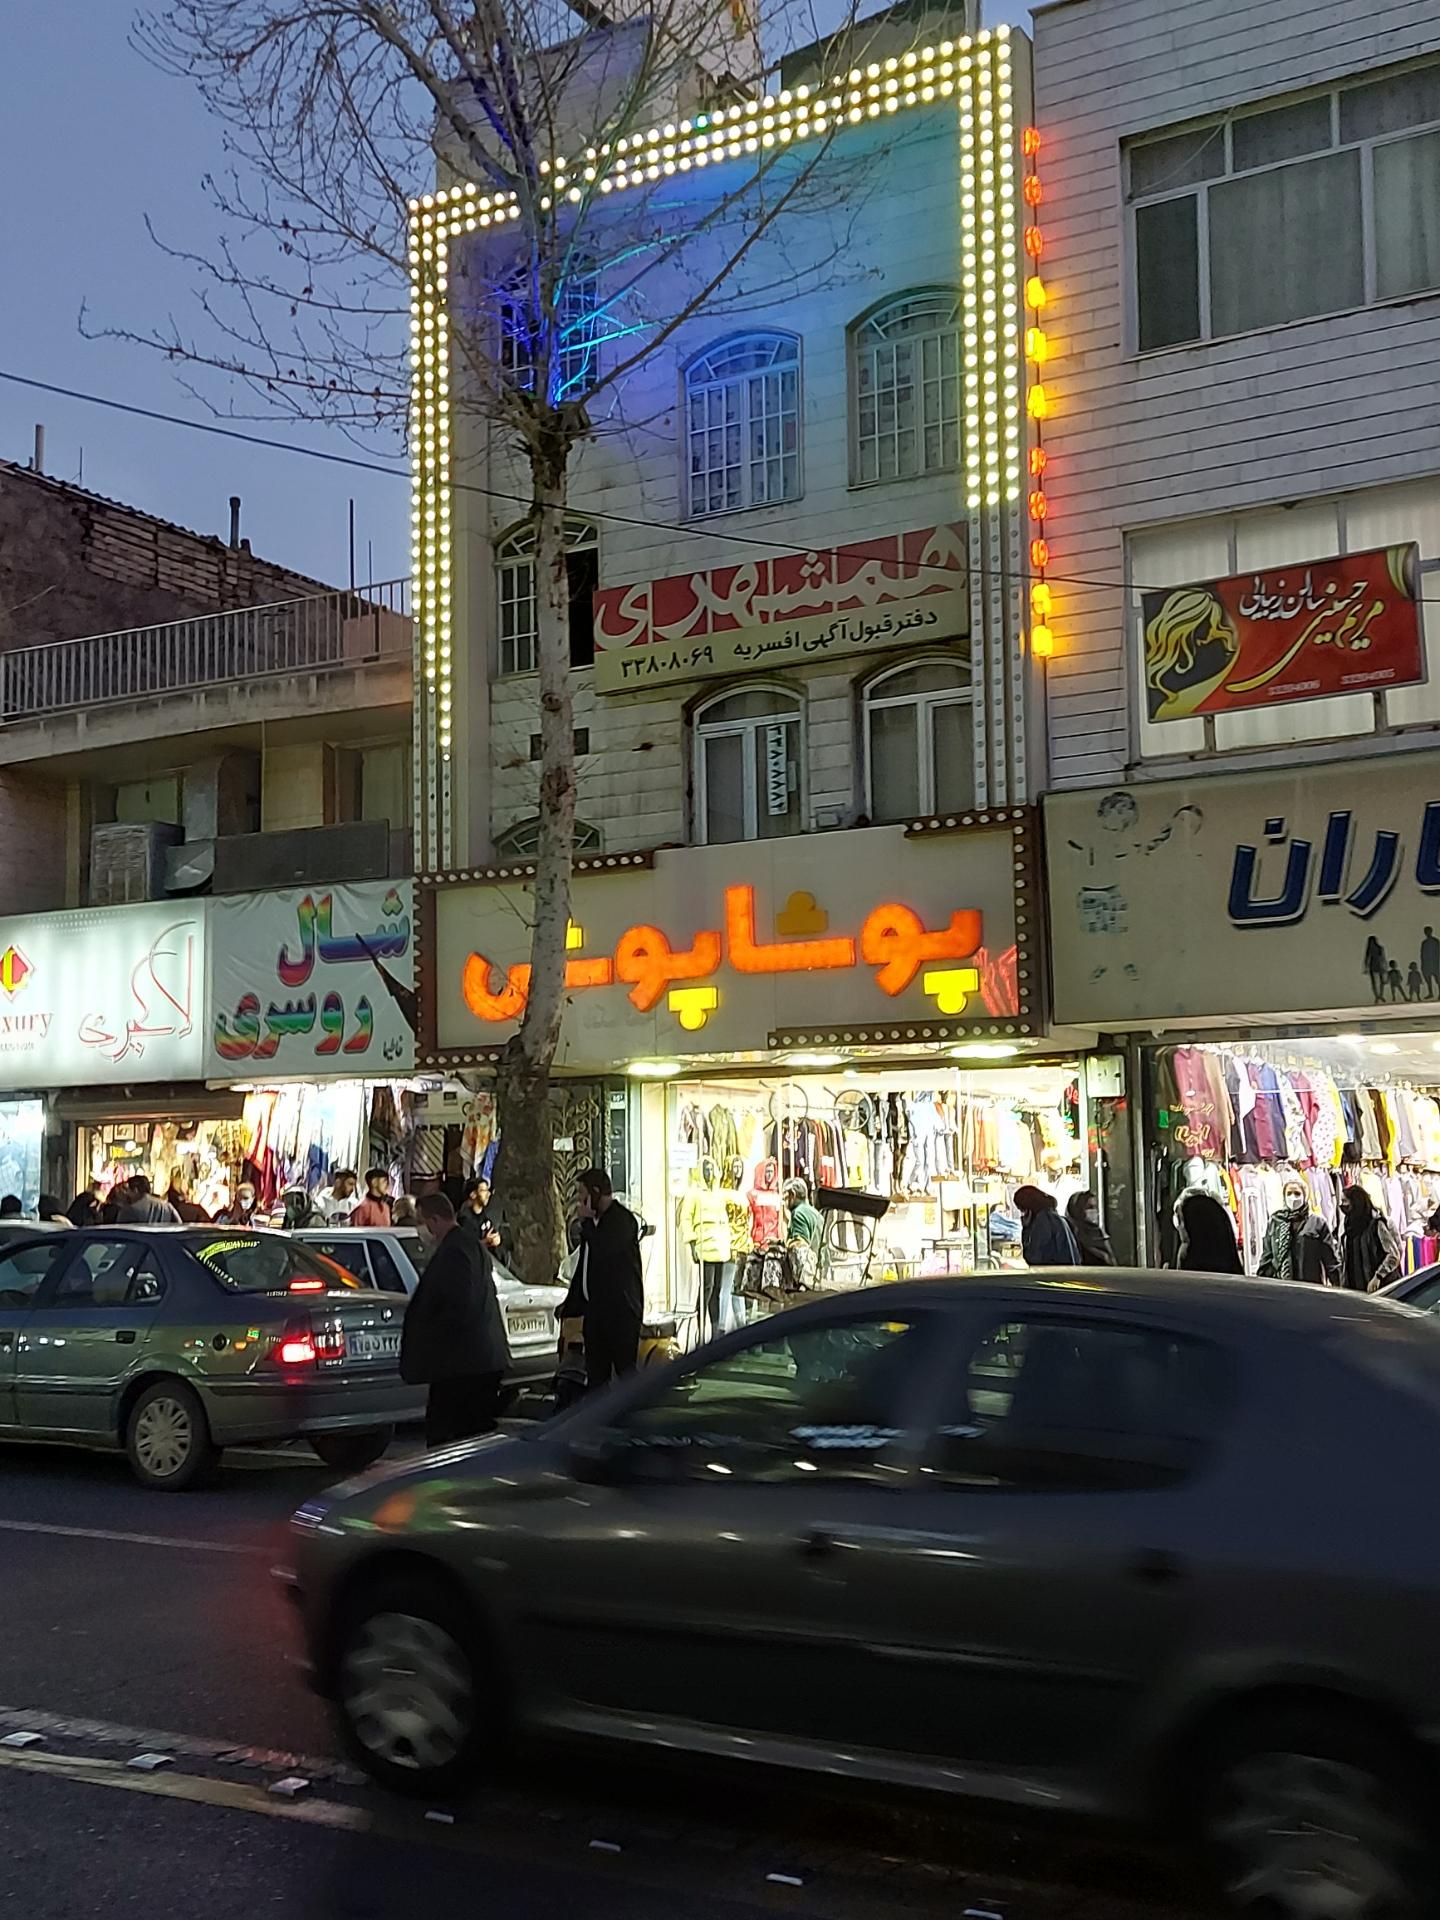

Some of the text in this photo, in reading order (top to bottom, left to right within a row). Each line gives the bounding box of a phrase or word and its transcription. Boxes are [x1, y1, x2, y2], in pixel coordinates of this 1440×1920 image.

[594, 522, 968, 650] همشهری
[1238, 568, 1327, 621] سالن زیبایی
[620, 606, 938, 680] دفتر قبول آگهی افسریه ۳۳۸۰۸۰۶۹
[1334, 598, 1386, 651] مریم
[277, 886, 410, 986] شال
[214, 990, 374, 1061] روسری
